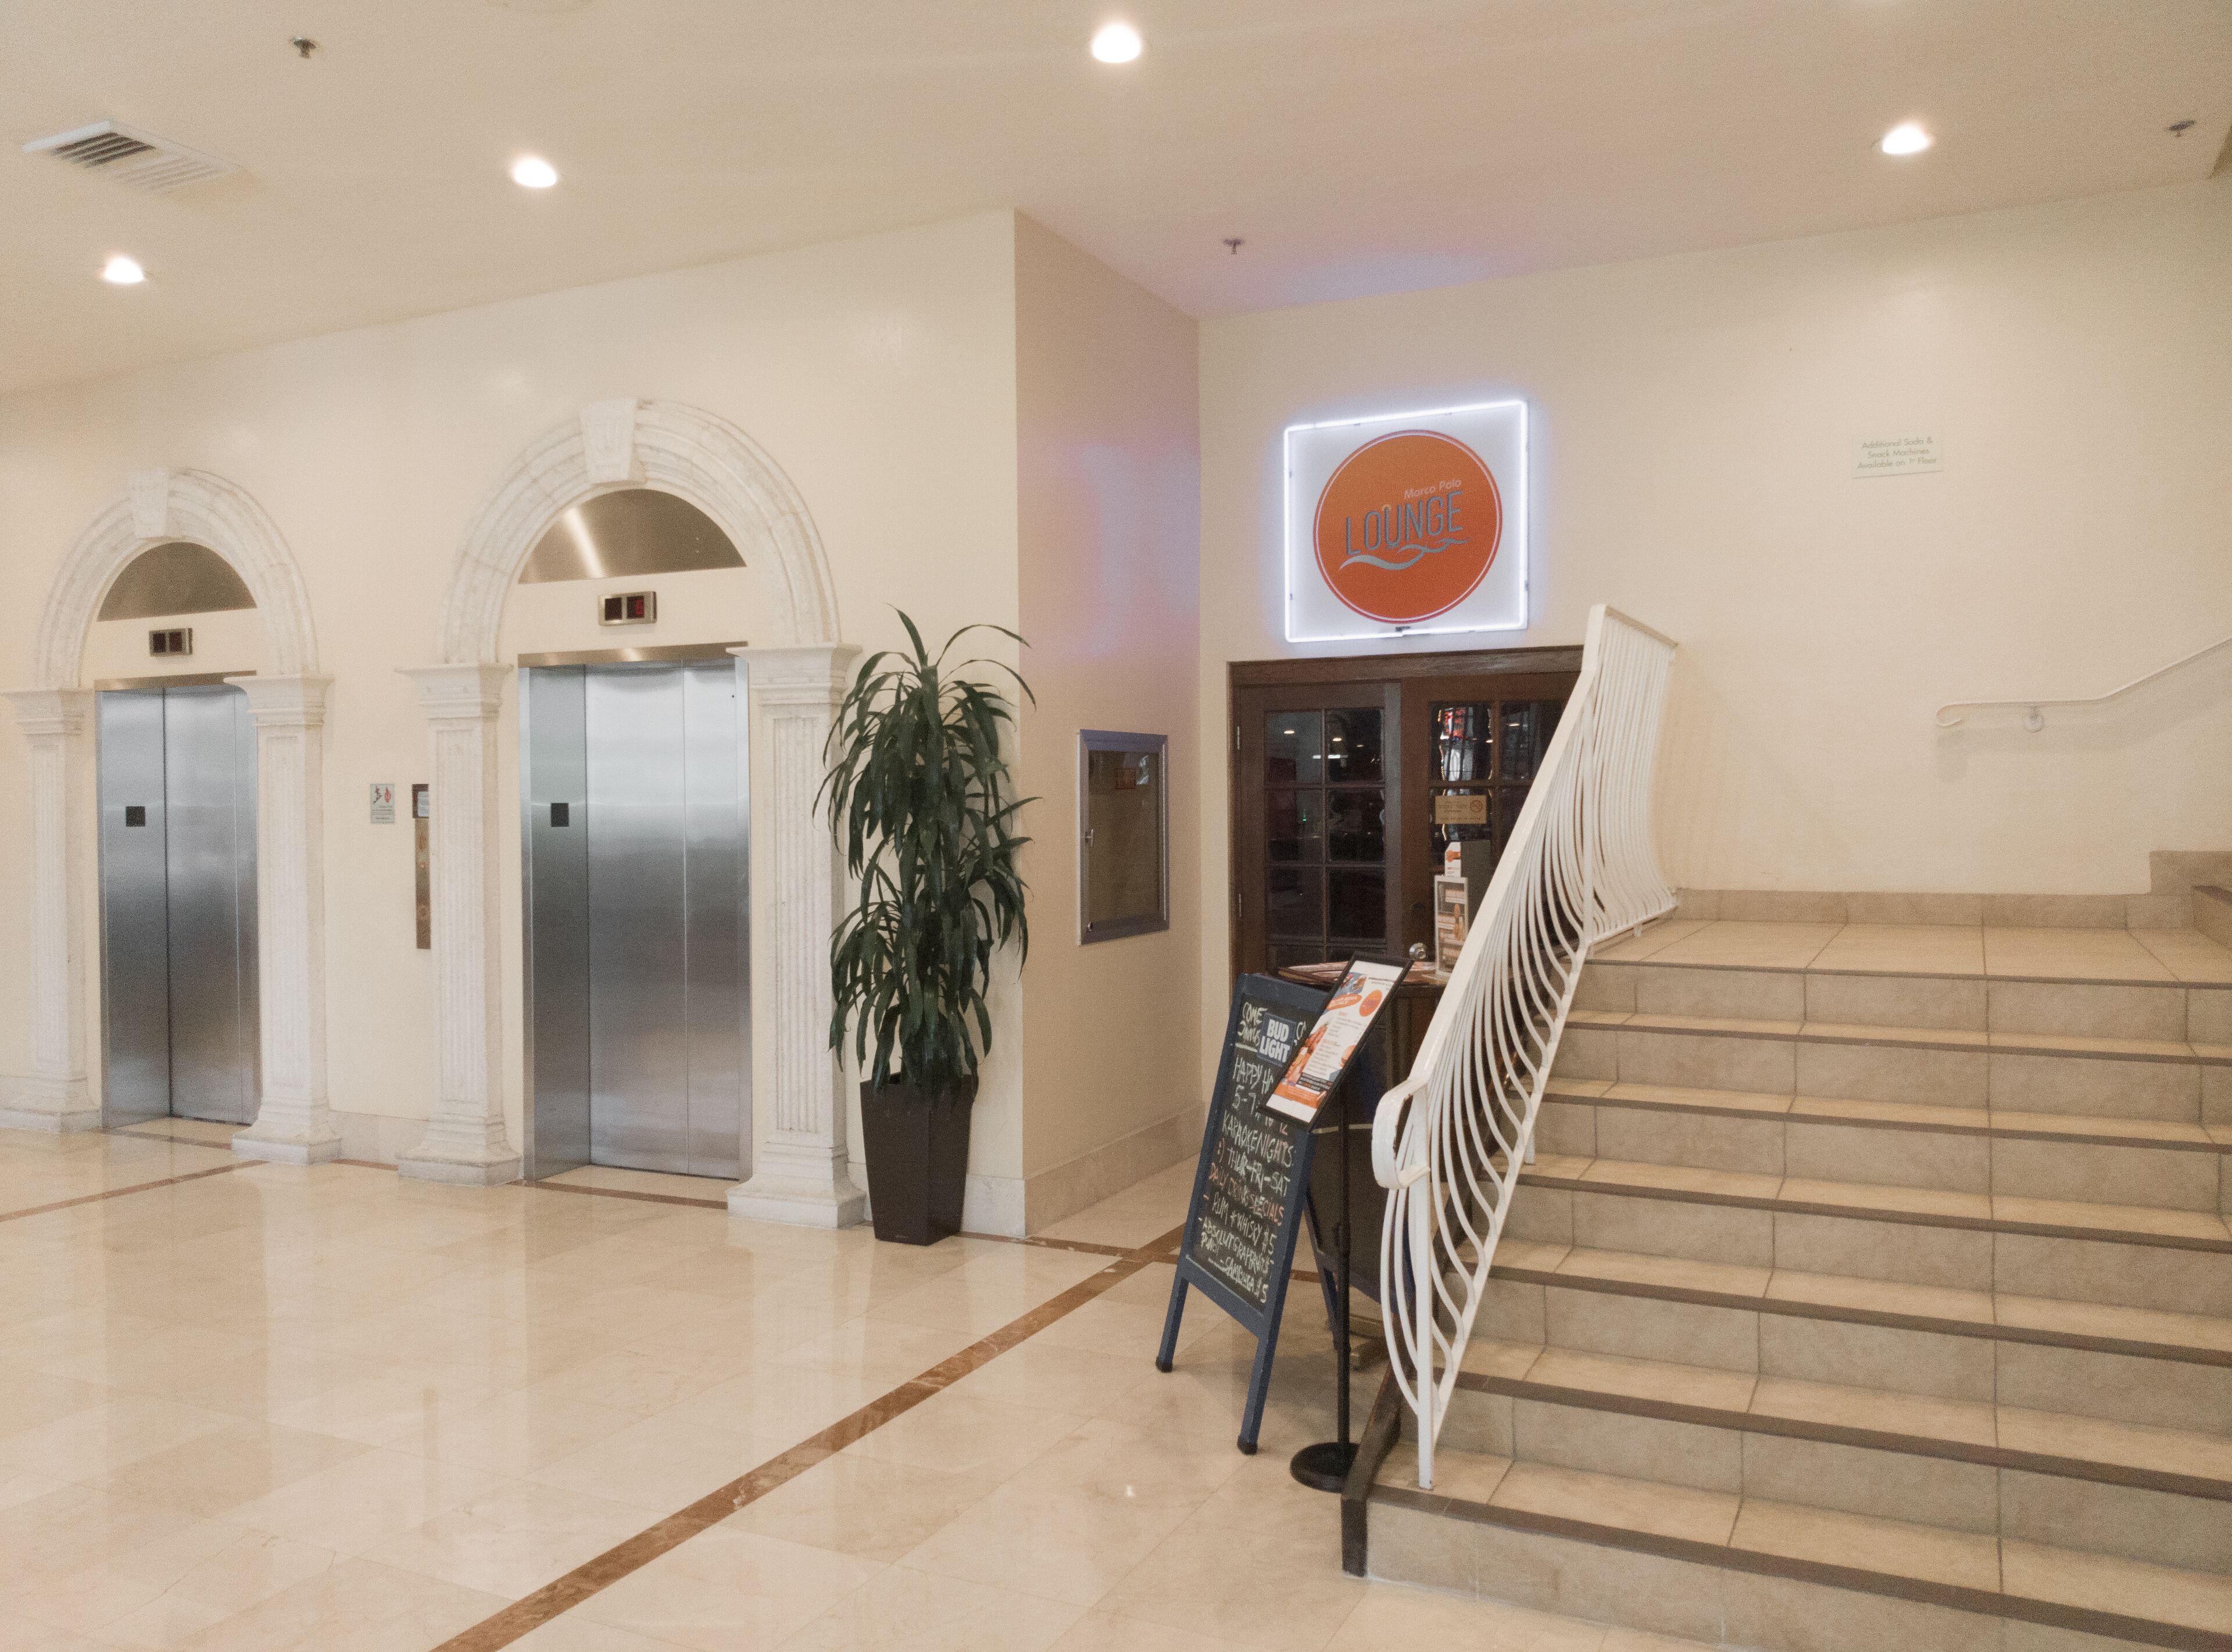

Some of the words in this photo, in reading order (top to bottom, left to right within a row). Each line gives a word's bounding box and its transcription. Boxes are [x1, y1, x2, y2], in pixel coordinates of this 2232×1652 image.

[1861, 438, 1901, 449] Additional
[1904, 437, 1923, 446] Soda
[1868, 450, 1890, 458] Snack
[1858, 459, 1893, 469] Available
[1918, 456, 1937, 464] Floor
[1404, 487, 1435, 500] Marco
[1439, 479, 1462, 491] Polo
[1346, 490, 1463, 555] LOUNGE
[1243, 1002, 1268, 1025] COME
[1267, 1019, 1289, 1042] BUD
[1259, 1035, 1290, 1063] LIGHT
[1233, 1055, 1263, 1090] HAPPY
